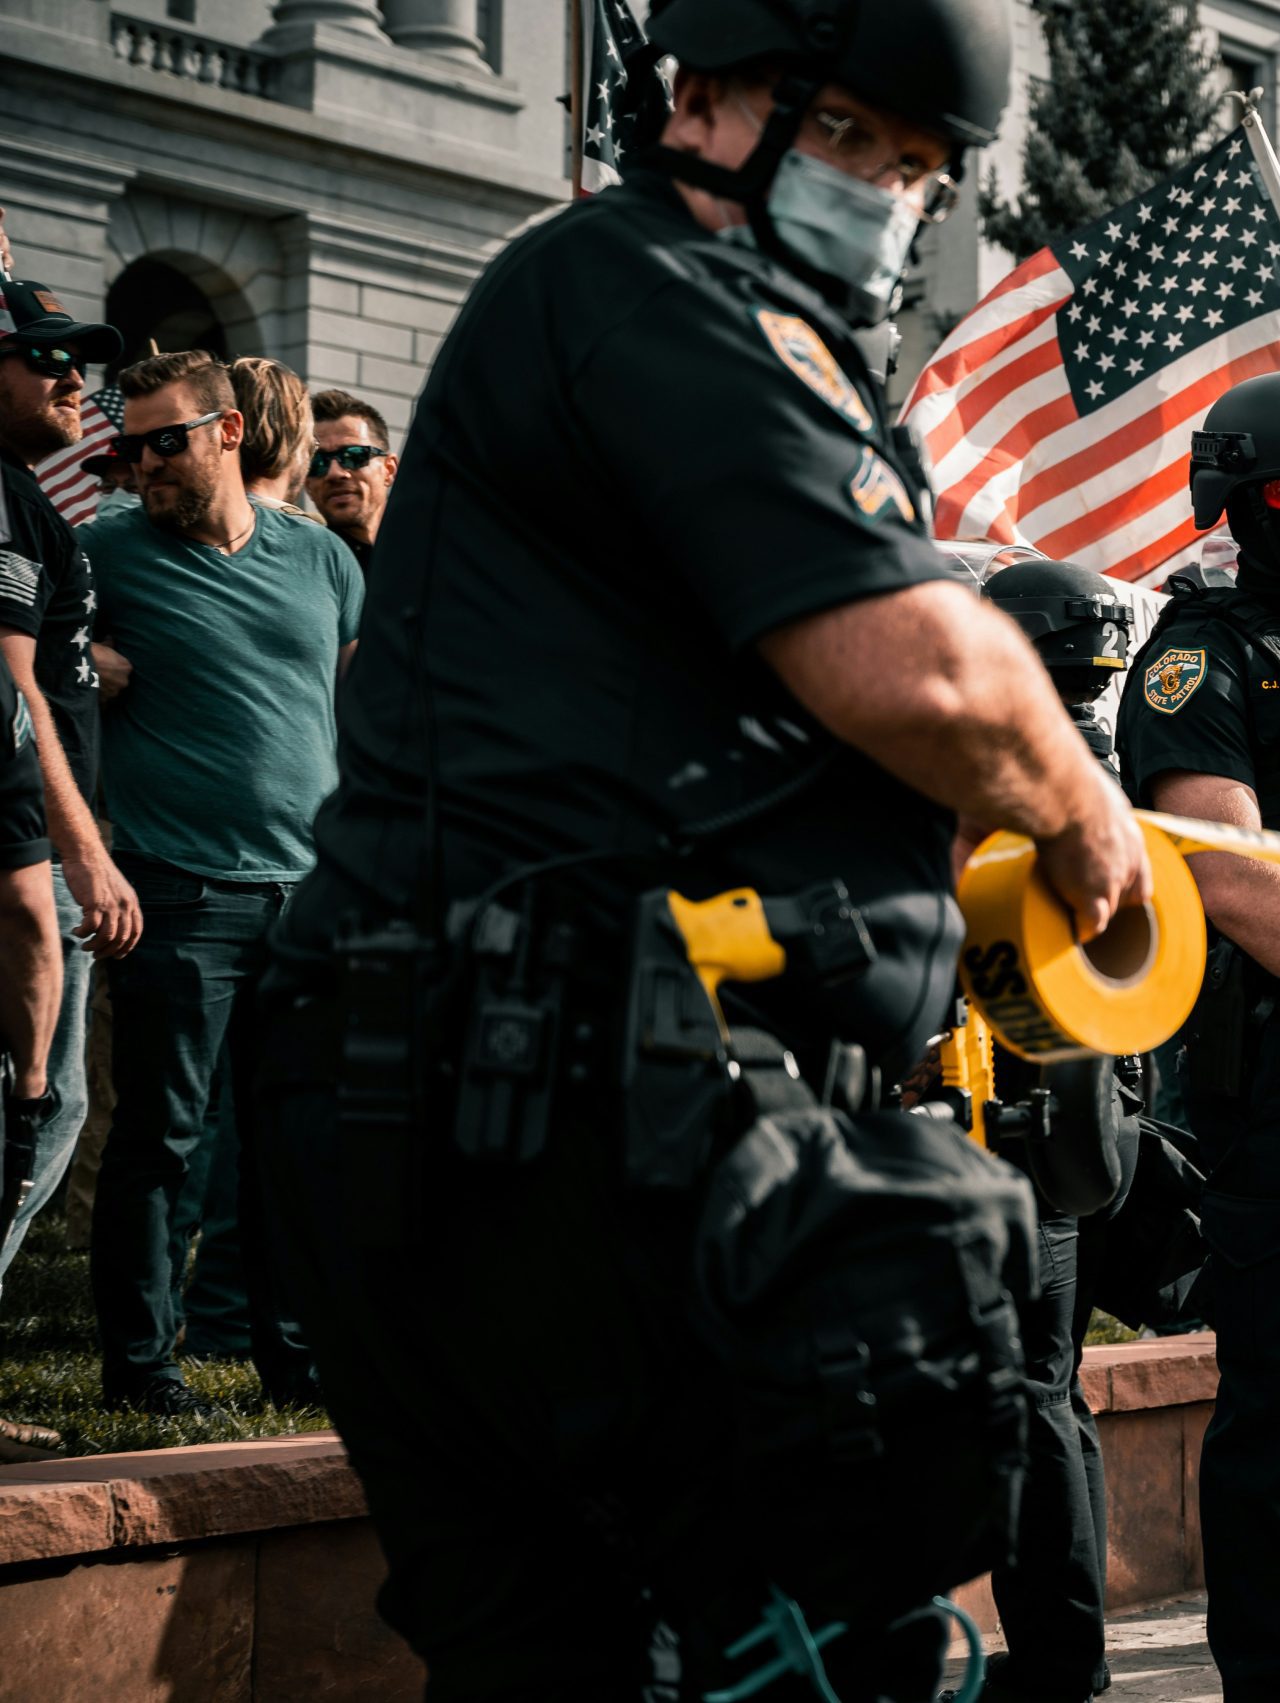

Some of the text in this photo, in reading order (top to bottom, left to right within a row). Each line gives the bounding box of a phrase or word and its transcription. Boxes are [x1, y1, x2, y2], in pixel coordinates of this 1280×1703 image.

[1148, 653, 1199, 679] COLORADO
[1148, 675, 1199, 705] STATE PATROL
